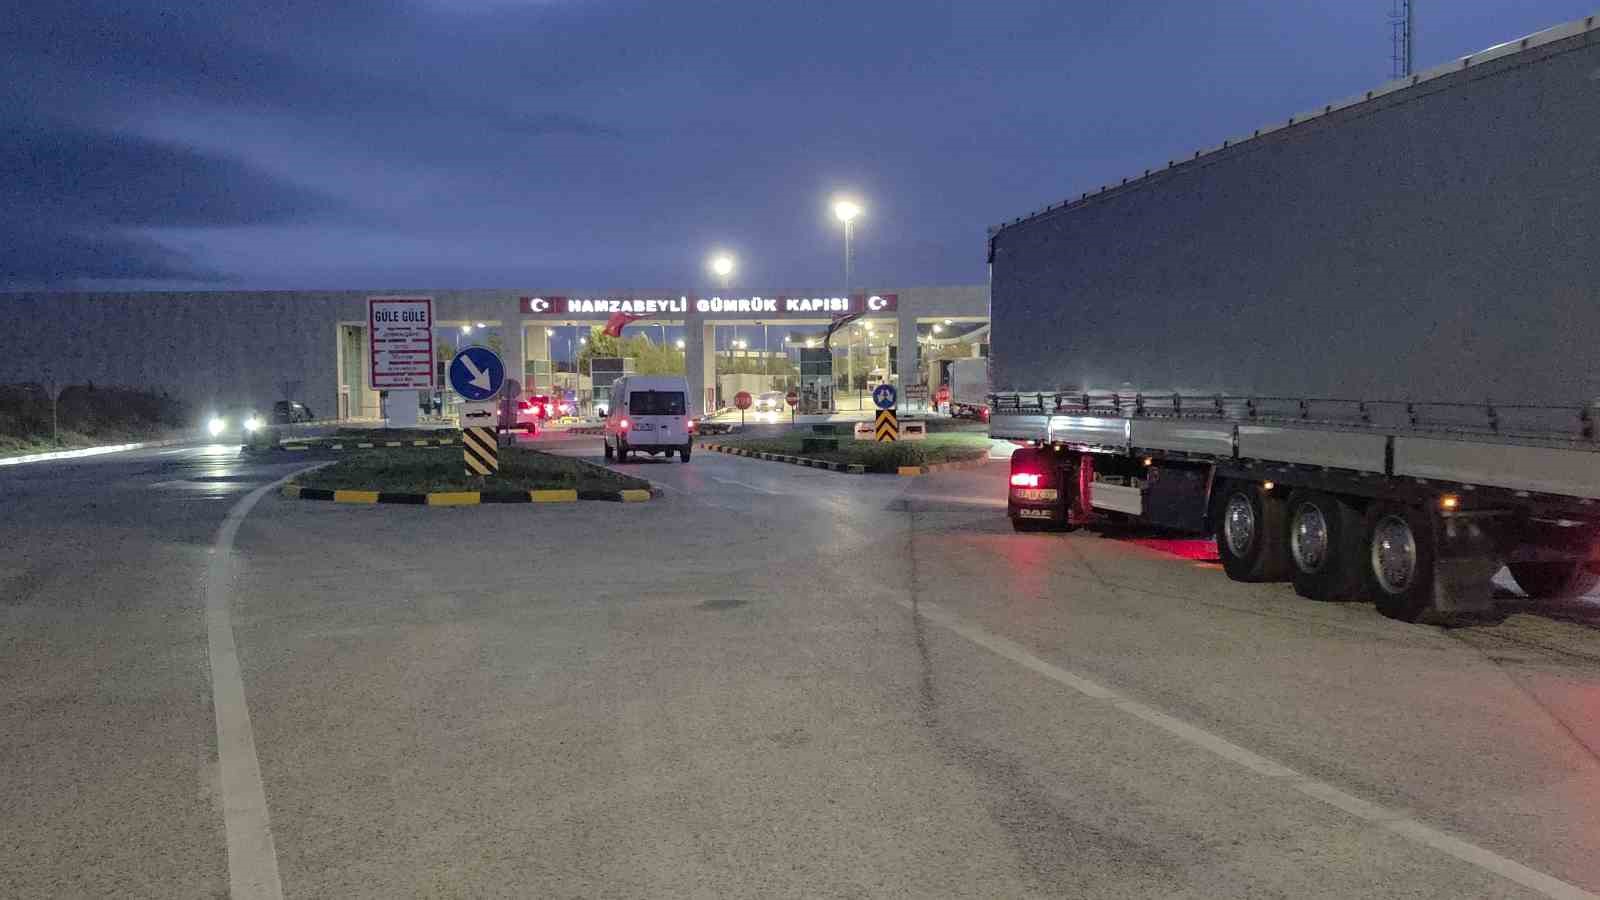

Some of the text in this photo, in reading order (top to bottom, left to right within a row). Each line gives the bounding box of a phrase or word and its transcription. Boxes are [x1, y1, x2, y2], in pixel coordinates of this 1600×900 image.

[568, 296, 849, 312] HAMZABEYLİ GÜMRÜK KAPISI
